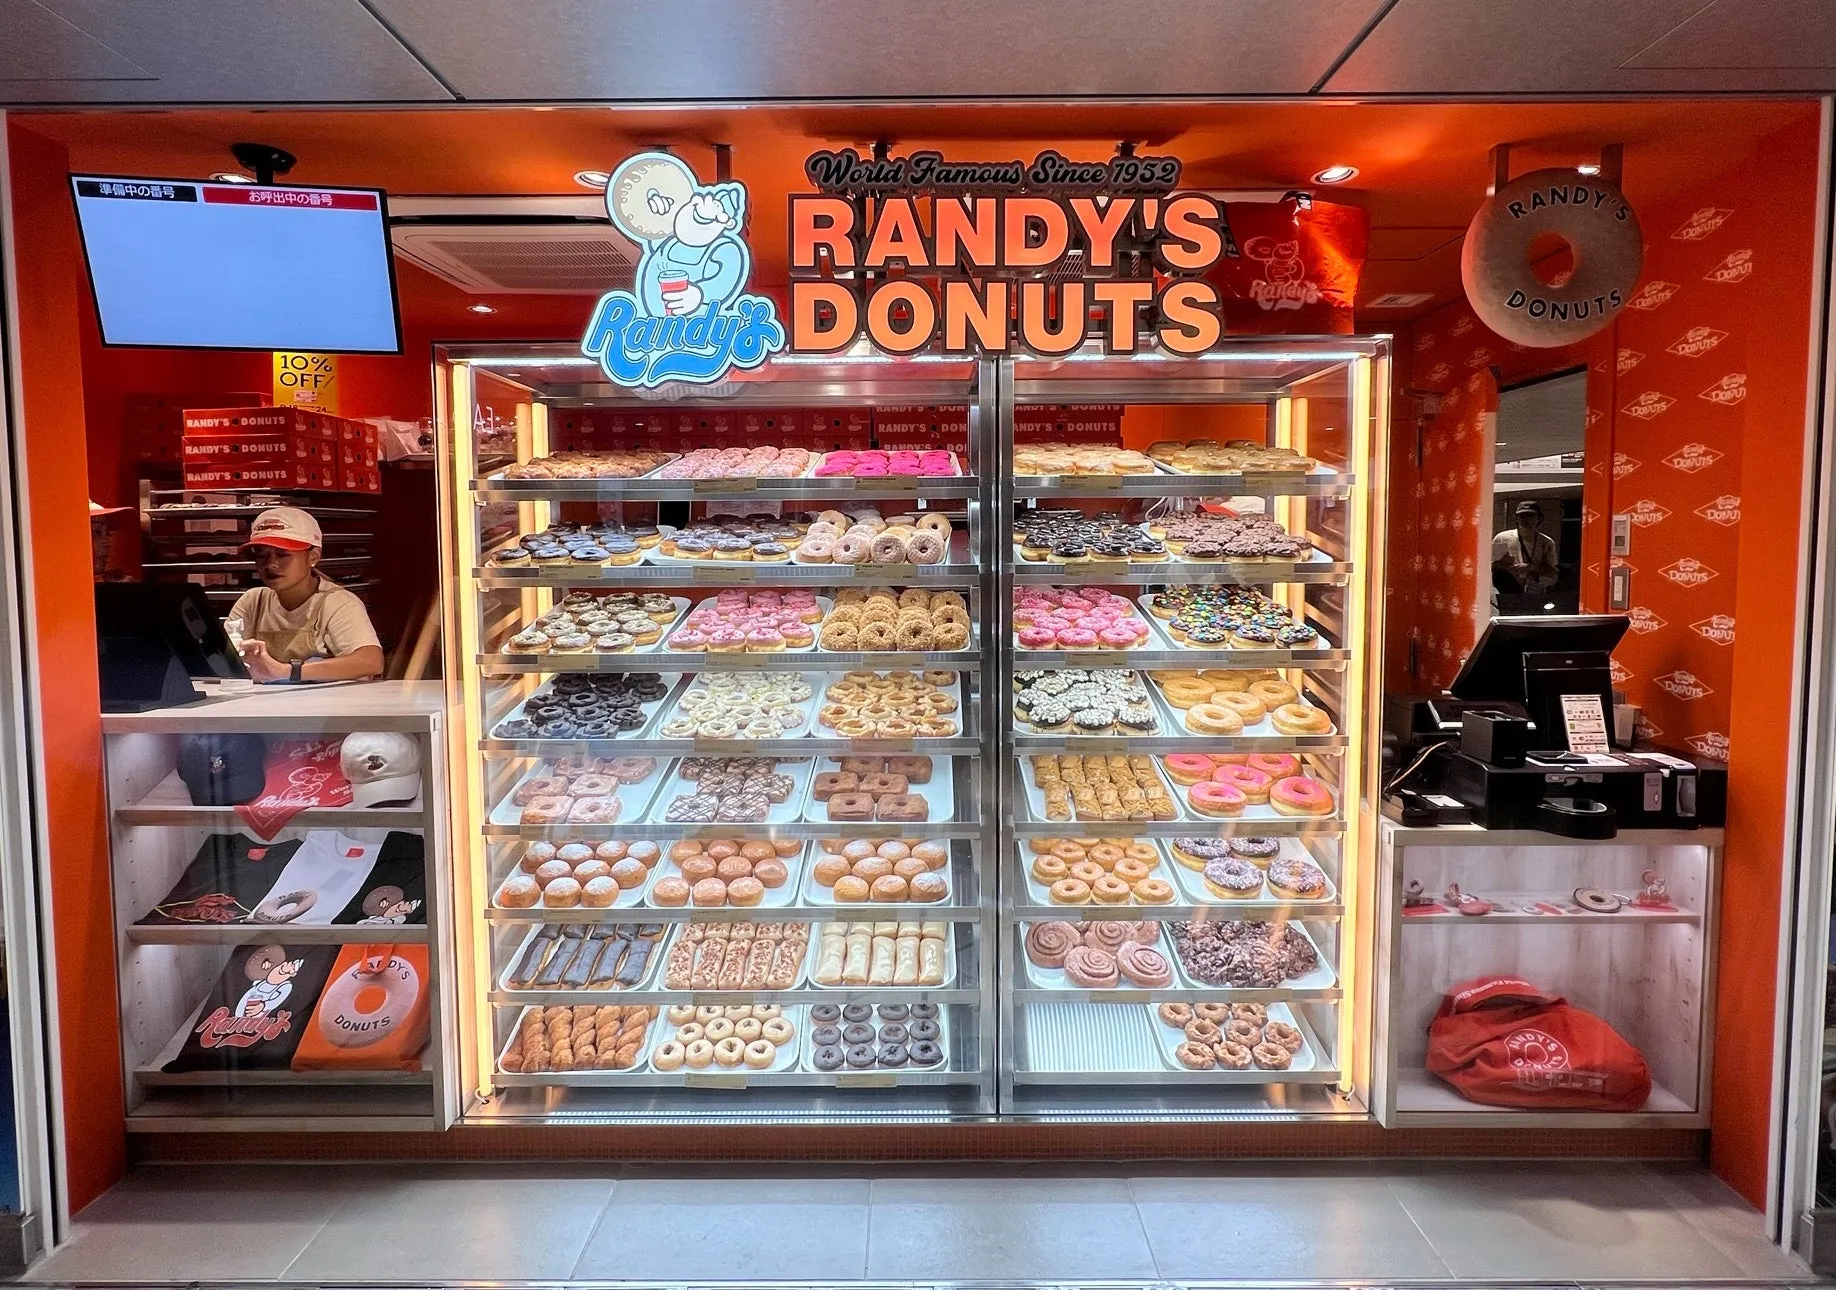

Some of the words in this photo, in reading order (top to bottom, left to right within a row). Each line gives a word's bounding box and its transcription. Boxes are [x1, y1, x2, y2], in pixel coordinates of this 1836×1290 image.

[810, 154, 903, 186] World
[909, 154, 1021, 187] Famous
[1031, 155, 1106, 184] Since
[1112, 161, 1179, 185] 1952
[99, 182, 176, 199] 準備中の番号
[248, 190, 333, 207] お呼出中の番号
[1507, 186, 1631, 221] RANDY'S
[792, 196, 1224, 269] RANDY'S
[1506, 287, 1623, 321] DONUTS
[792, 279, 1223, 354] DONUTS
[585, 295, 780, 383] Randy's
[280, 355, 333, 372] 10%
[186, 418, 230, 428] RANDY'S
[240, 416, 286, 425] DONUTS
[878, 423, 927, 432] RANDY'S
[1067, 422, 1116, 431] DONUTS
[185, 445, 230, 454] RANDY'S
[241, 443, 287, 452] DONUTS
[187, 471, 231, 482] RANDY'S
[242, 470, 287, 480] DONUTS
[1664, 680, 1703, 698] DONUTS
[195, 1006, 293, 1049] Randy's
[334, 1014, 391, 1032] DONUTS
